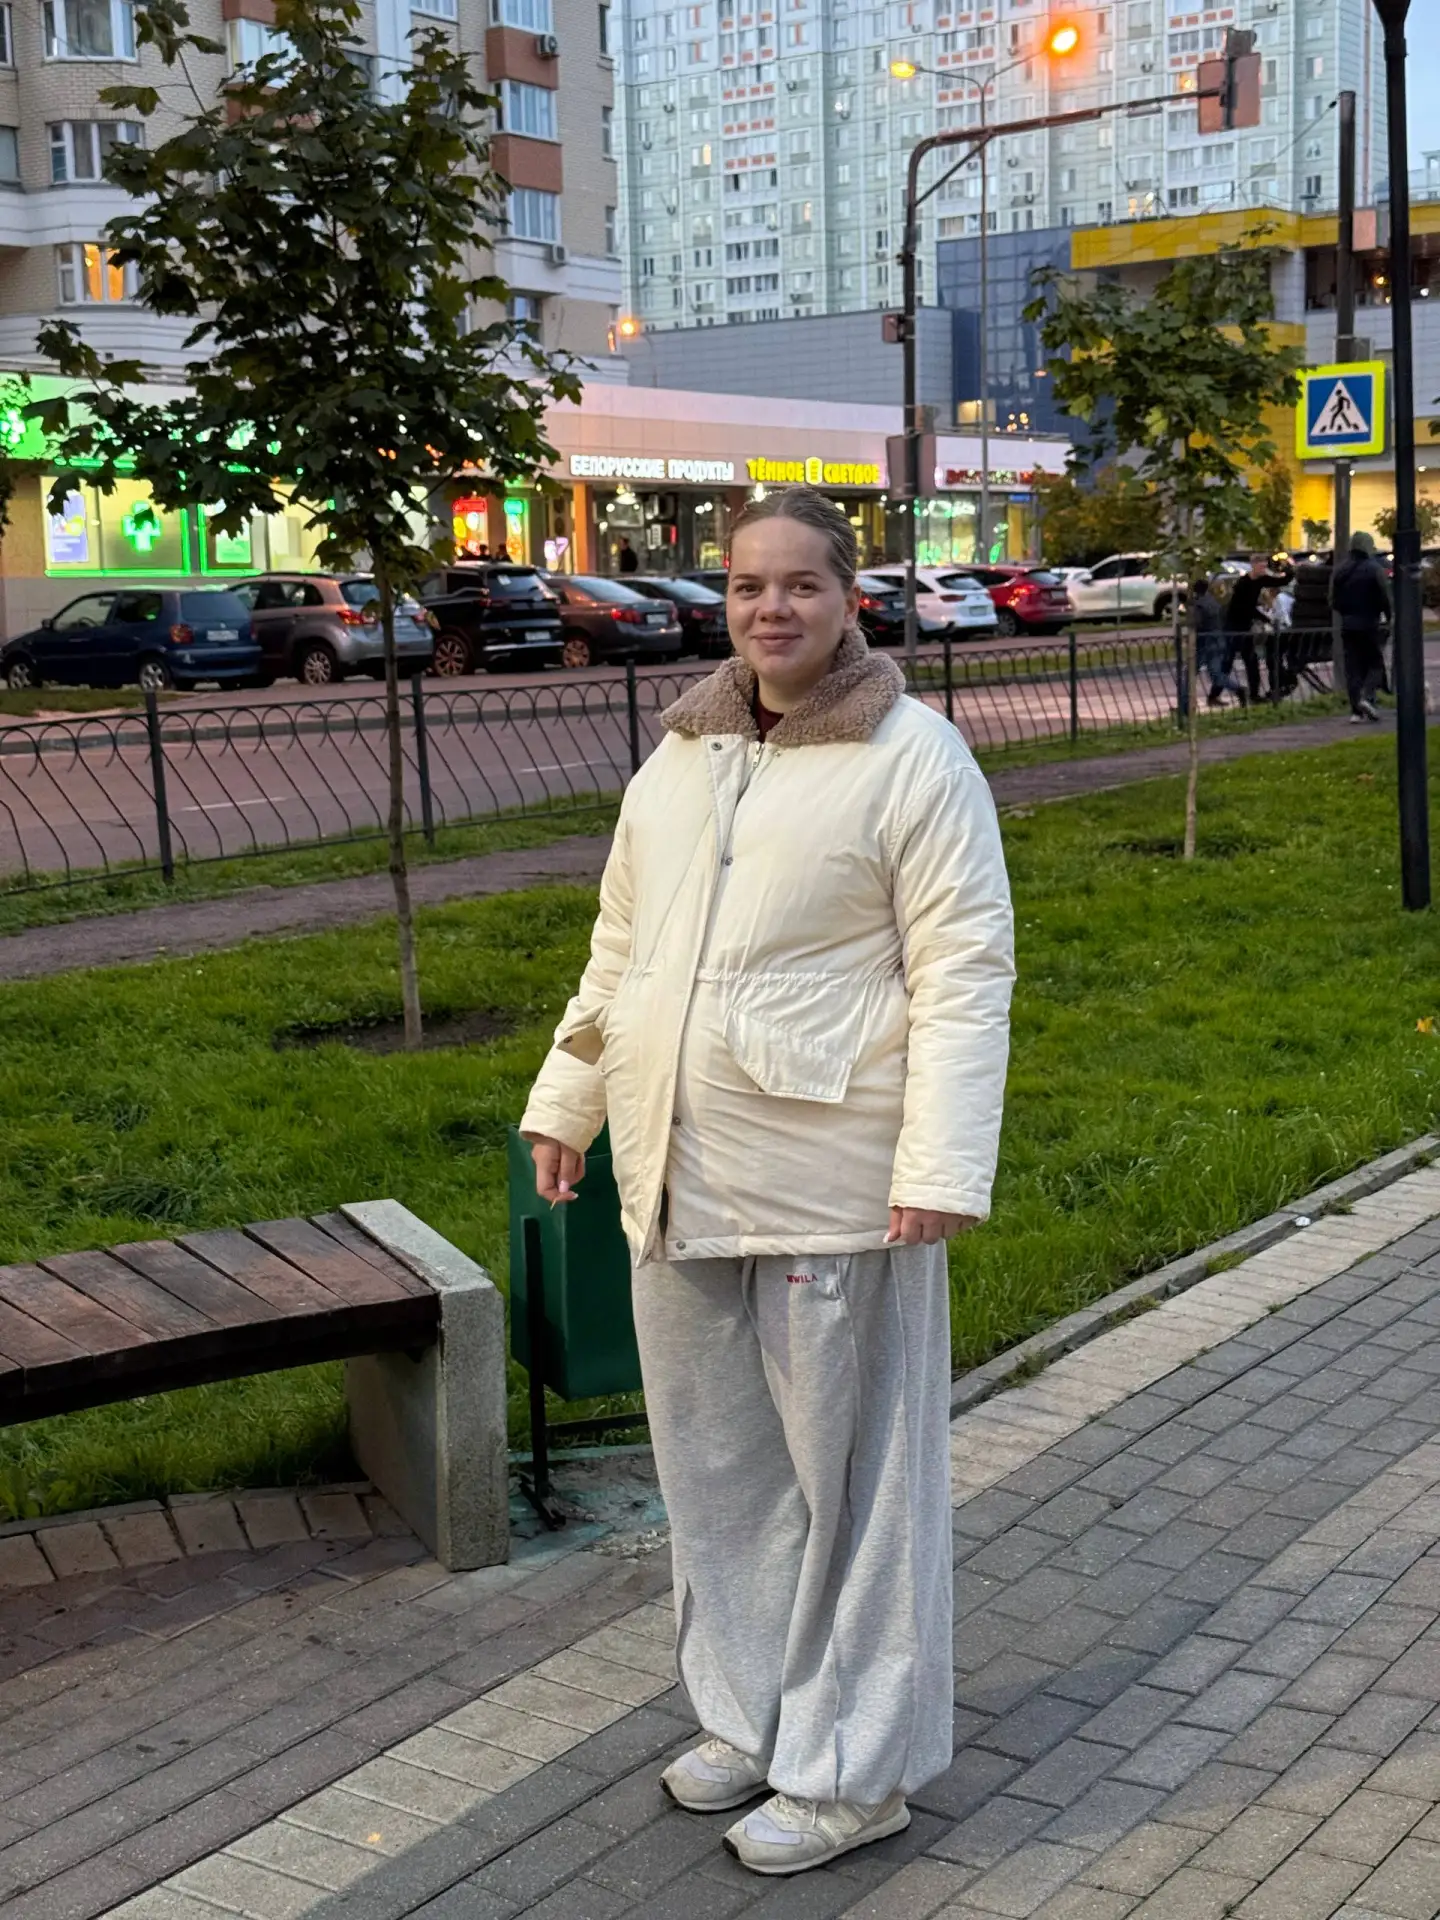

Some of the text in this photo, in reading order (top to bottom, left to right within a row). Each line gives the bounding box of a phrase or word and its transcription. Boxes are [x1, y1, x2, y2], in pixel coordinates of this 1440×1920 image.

[570, 455, 734, 482] БЕЛОРУССКИЕ ПРОДУКТЫ
[747, 457, 880, 485] ТЁМНОЕ СВЕТЛОЕ
